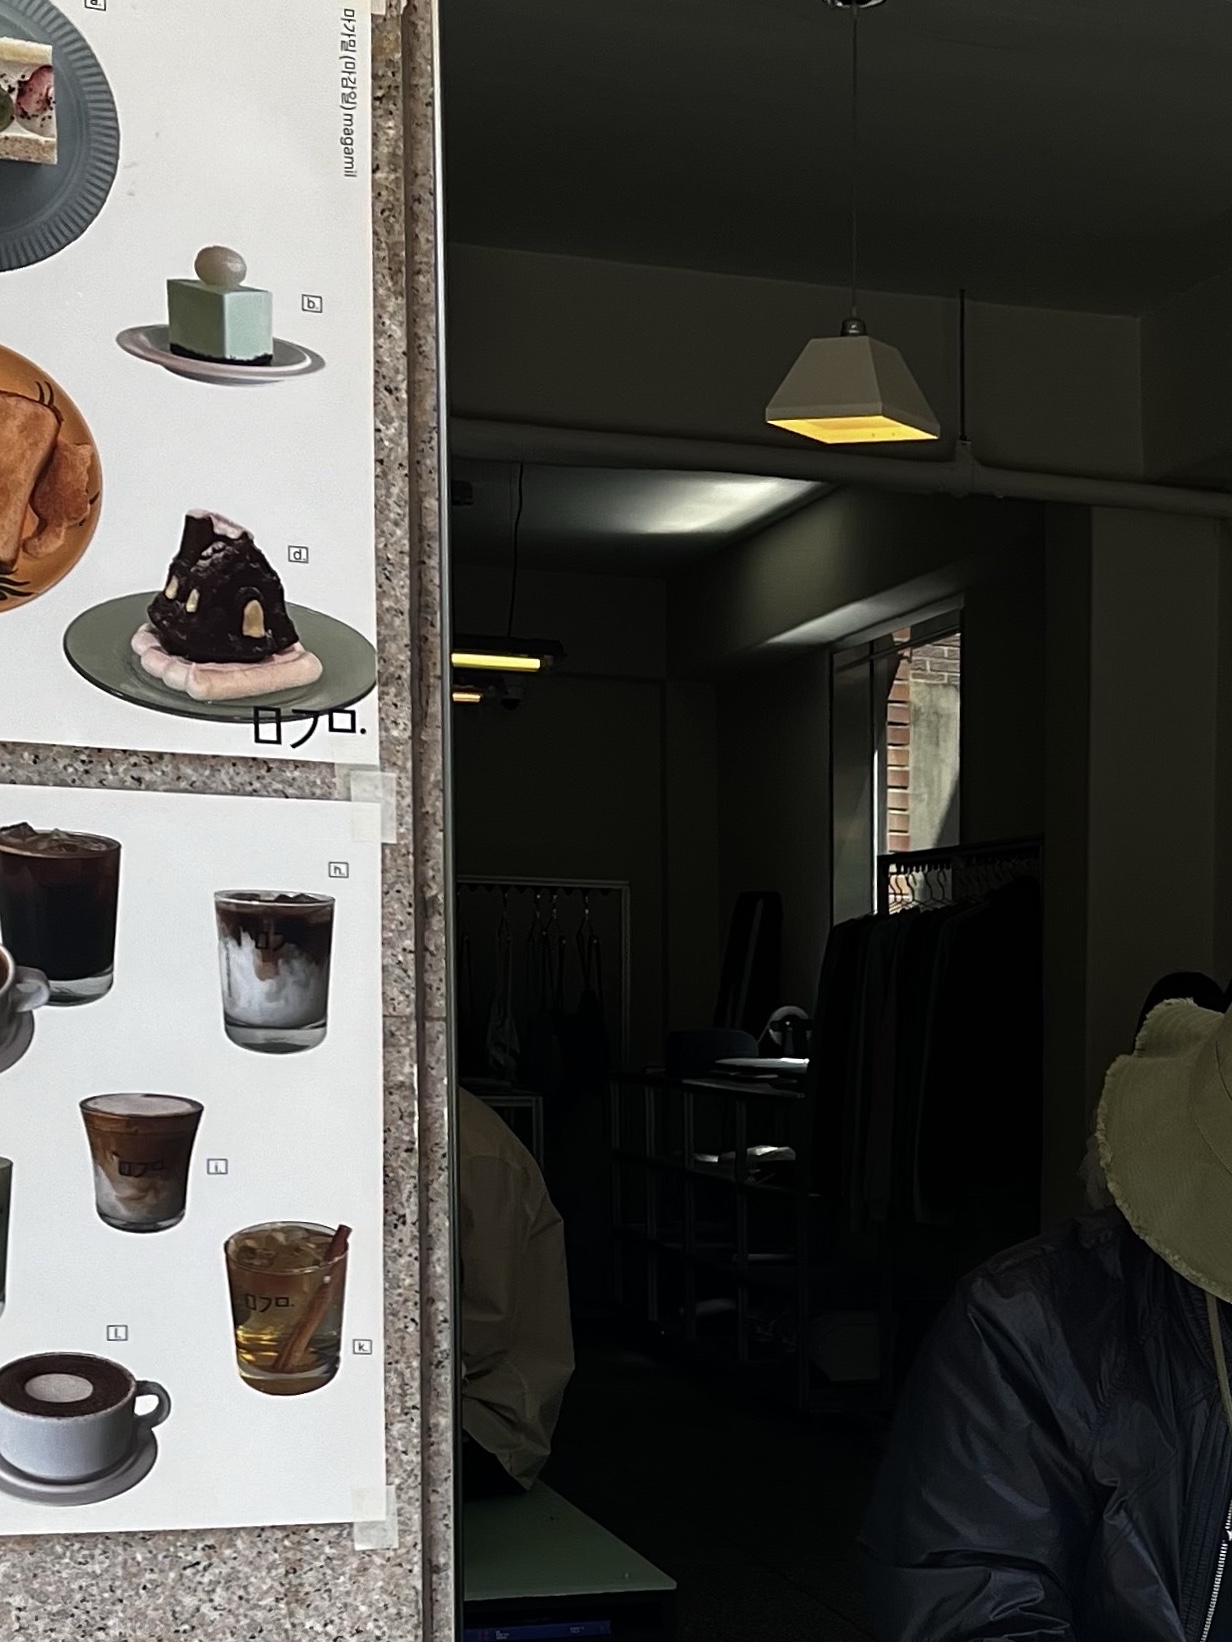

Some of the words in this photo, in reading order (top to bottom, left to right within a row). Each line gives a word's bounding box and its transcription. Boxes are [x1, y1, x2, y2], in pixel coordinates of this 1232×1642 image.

[340, 113, 357, 178] magamil
[306, 297, 320, 310] b.
[293, 548, 306, 561] d.
